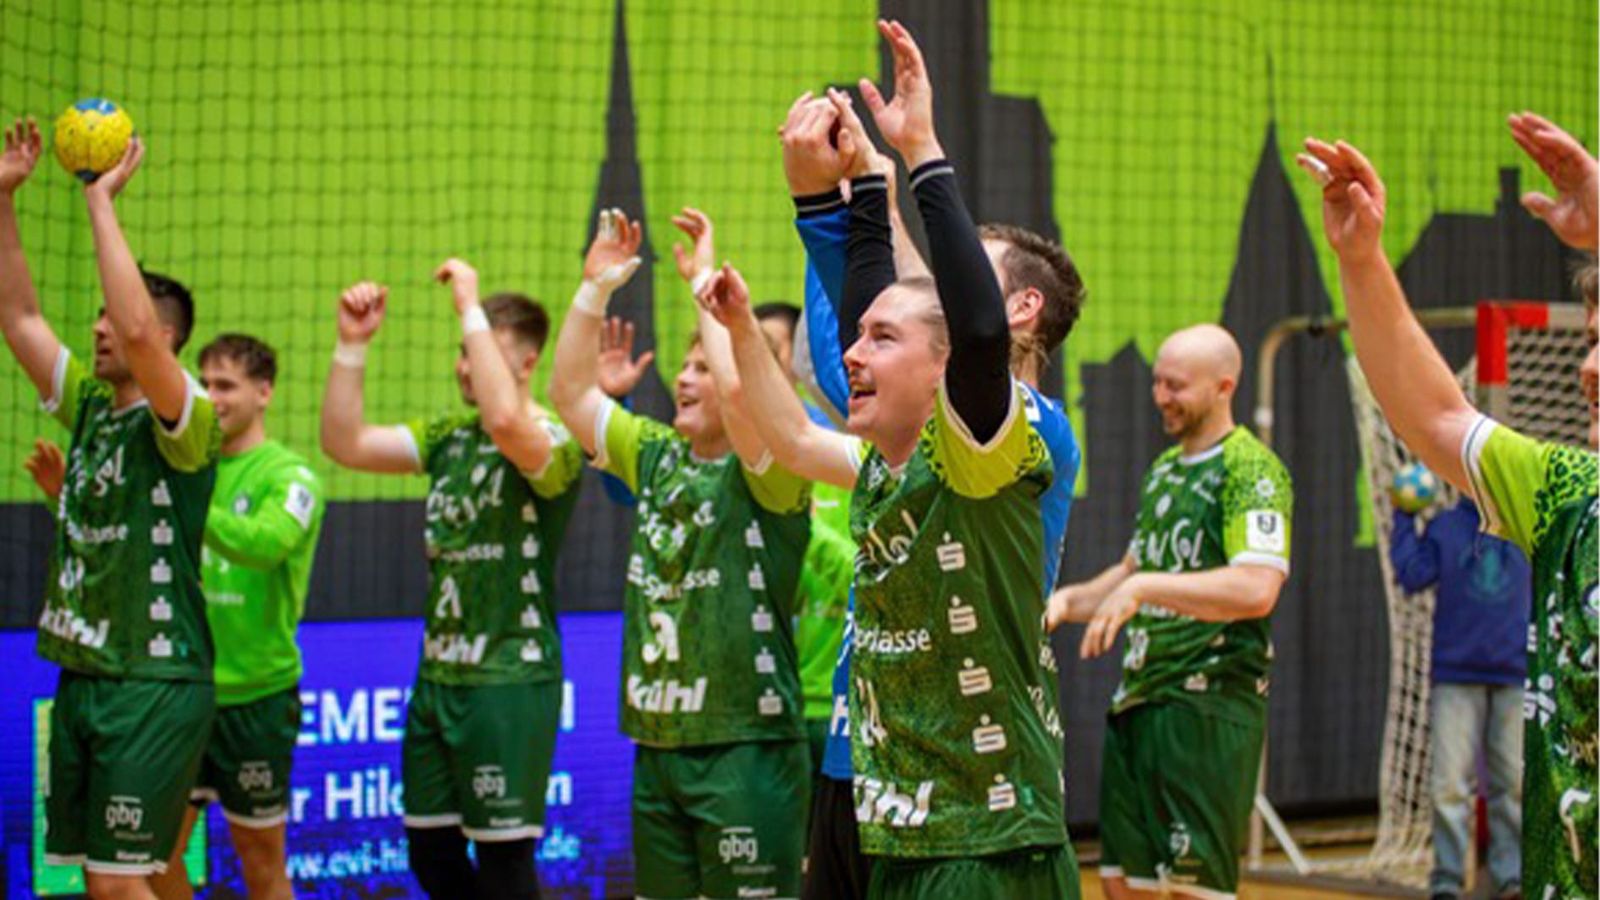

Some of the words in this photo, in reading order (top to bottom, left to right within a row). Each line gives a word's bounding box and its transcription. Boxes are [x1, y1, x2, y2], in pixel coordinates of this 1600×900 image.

[105, 800, 143, 829] gbg
[854, 774, 934, 827] ühl
[718, 834, 758, 865] gbg
